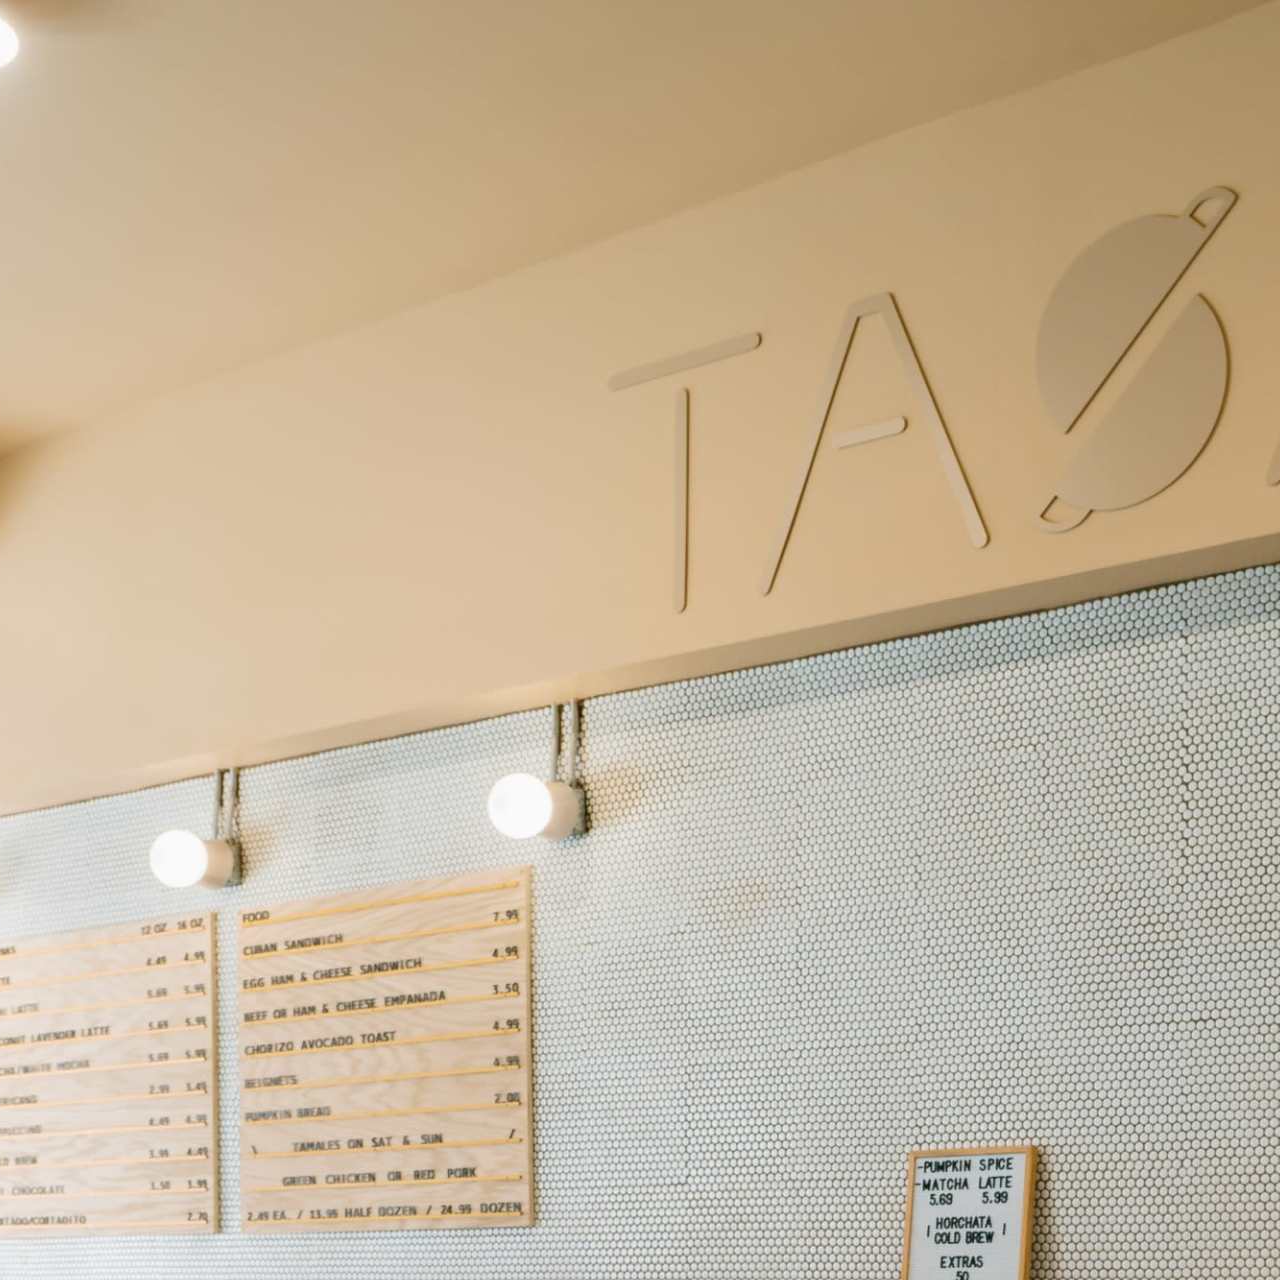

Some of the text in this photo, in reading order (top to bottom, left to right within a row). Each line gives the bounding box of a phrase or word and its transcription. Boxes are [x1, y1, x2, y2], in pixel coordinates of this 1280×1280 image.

[242, 910, 270, 923] FOOD
[153, 922, 168, 933] OZ
[189, 917, 203, 928] OZ
[243, 942, 278, 956] CUBAN
[284, 934, 344, 950] SANDWICH
[243, 946, 518, 990] EGG HAM & CHEESE SANDWICH 4.99
[11, 1003, 39, 1014] LATTE
[244, 1010, 268, 1022] BEEF
[273, 1008, 287, 1020] OR
[293, 1004, 316, 1017] HAM
[322, 1003, 329, 1014] &
[336, 998, 376, 1012] CHEESE
[384, 990, 446, 1007] EMPANADA
[31, 1030, 76, 1043] LAVENDER
[80, 1026, 110, 1038] LATTE
[244, 1018, 520, 1056] CHORIZO AVOCADO TOAST 4.99
[244, 1075, 298, 1088] BEIGNETS
[244, 1108, 292, 1122] PUMPKIN
[297, 1106, 331, 1118] BREAD
[293, 1134, 443, 1152] TAMALES ON SAT & SUN
[978, 1157, 1014, 1172] SPICE
[282, 1167, 477, 1186] GREEN CHICKEN OR RED PORK
[978, 1176, 1012, 1188] LATTE
[11, 1184, 65, 1196] CHOCOLATE
[929, 1191, 1008, 1206] 5.69 5.99
[344, 1207, 372, 1218] HALF
[378, 1206, 417, 1216] DOZEN
[480, 1202, 522, 1213] DOZEN
[936, 1216, 992, 1229] HORCHATA
[934, 1231, 994, 1244] COLD BREW
[940, 1256, 984, 1268] EXTRAS
